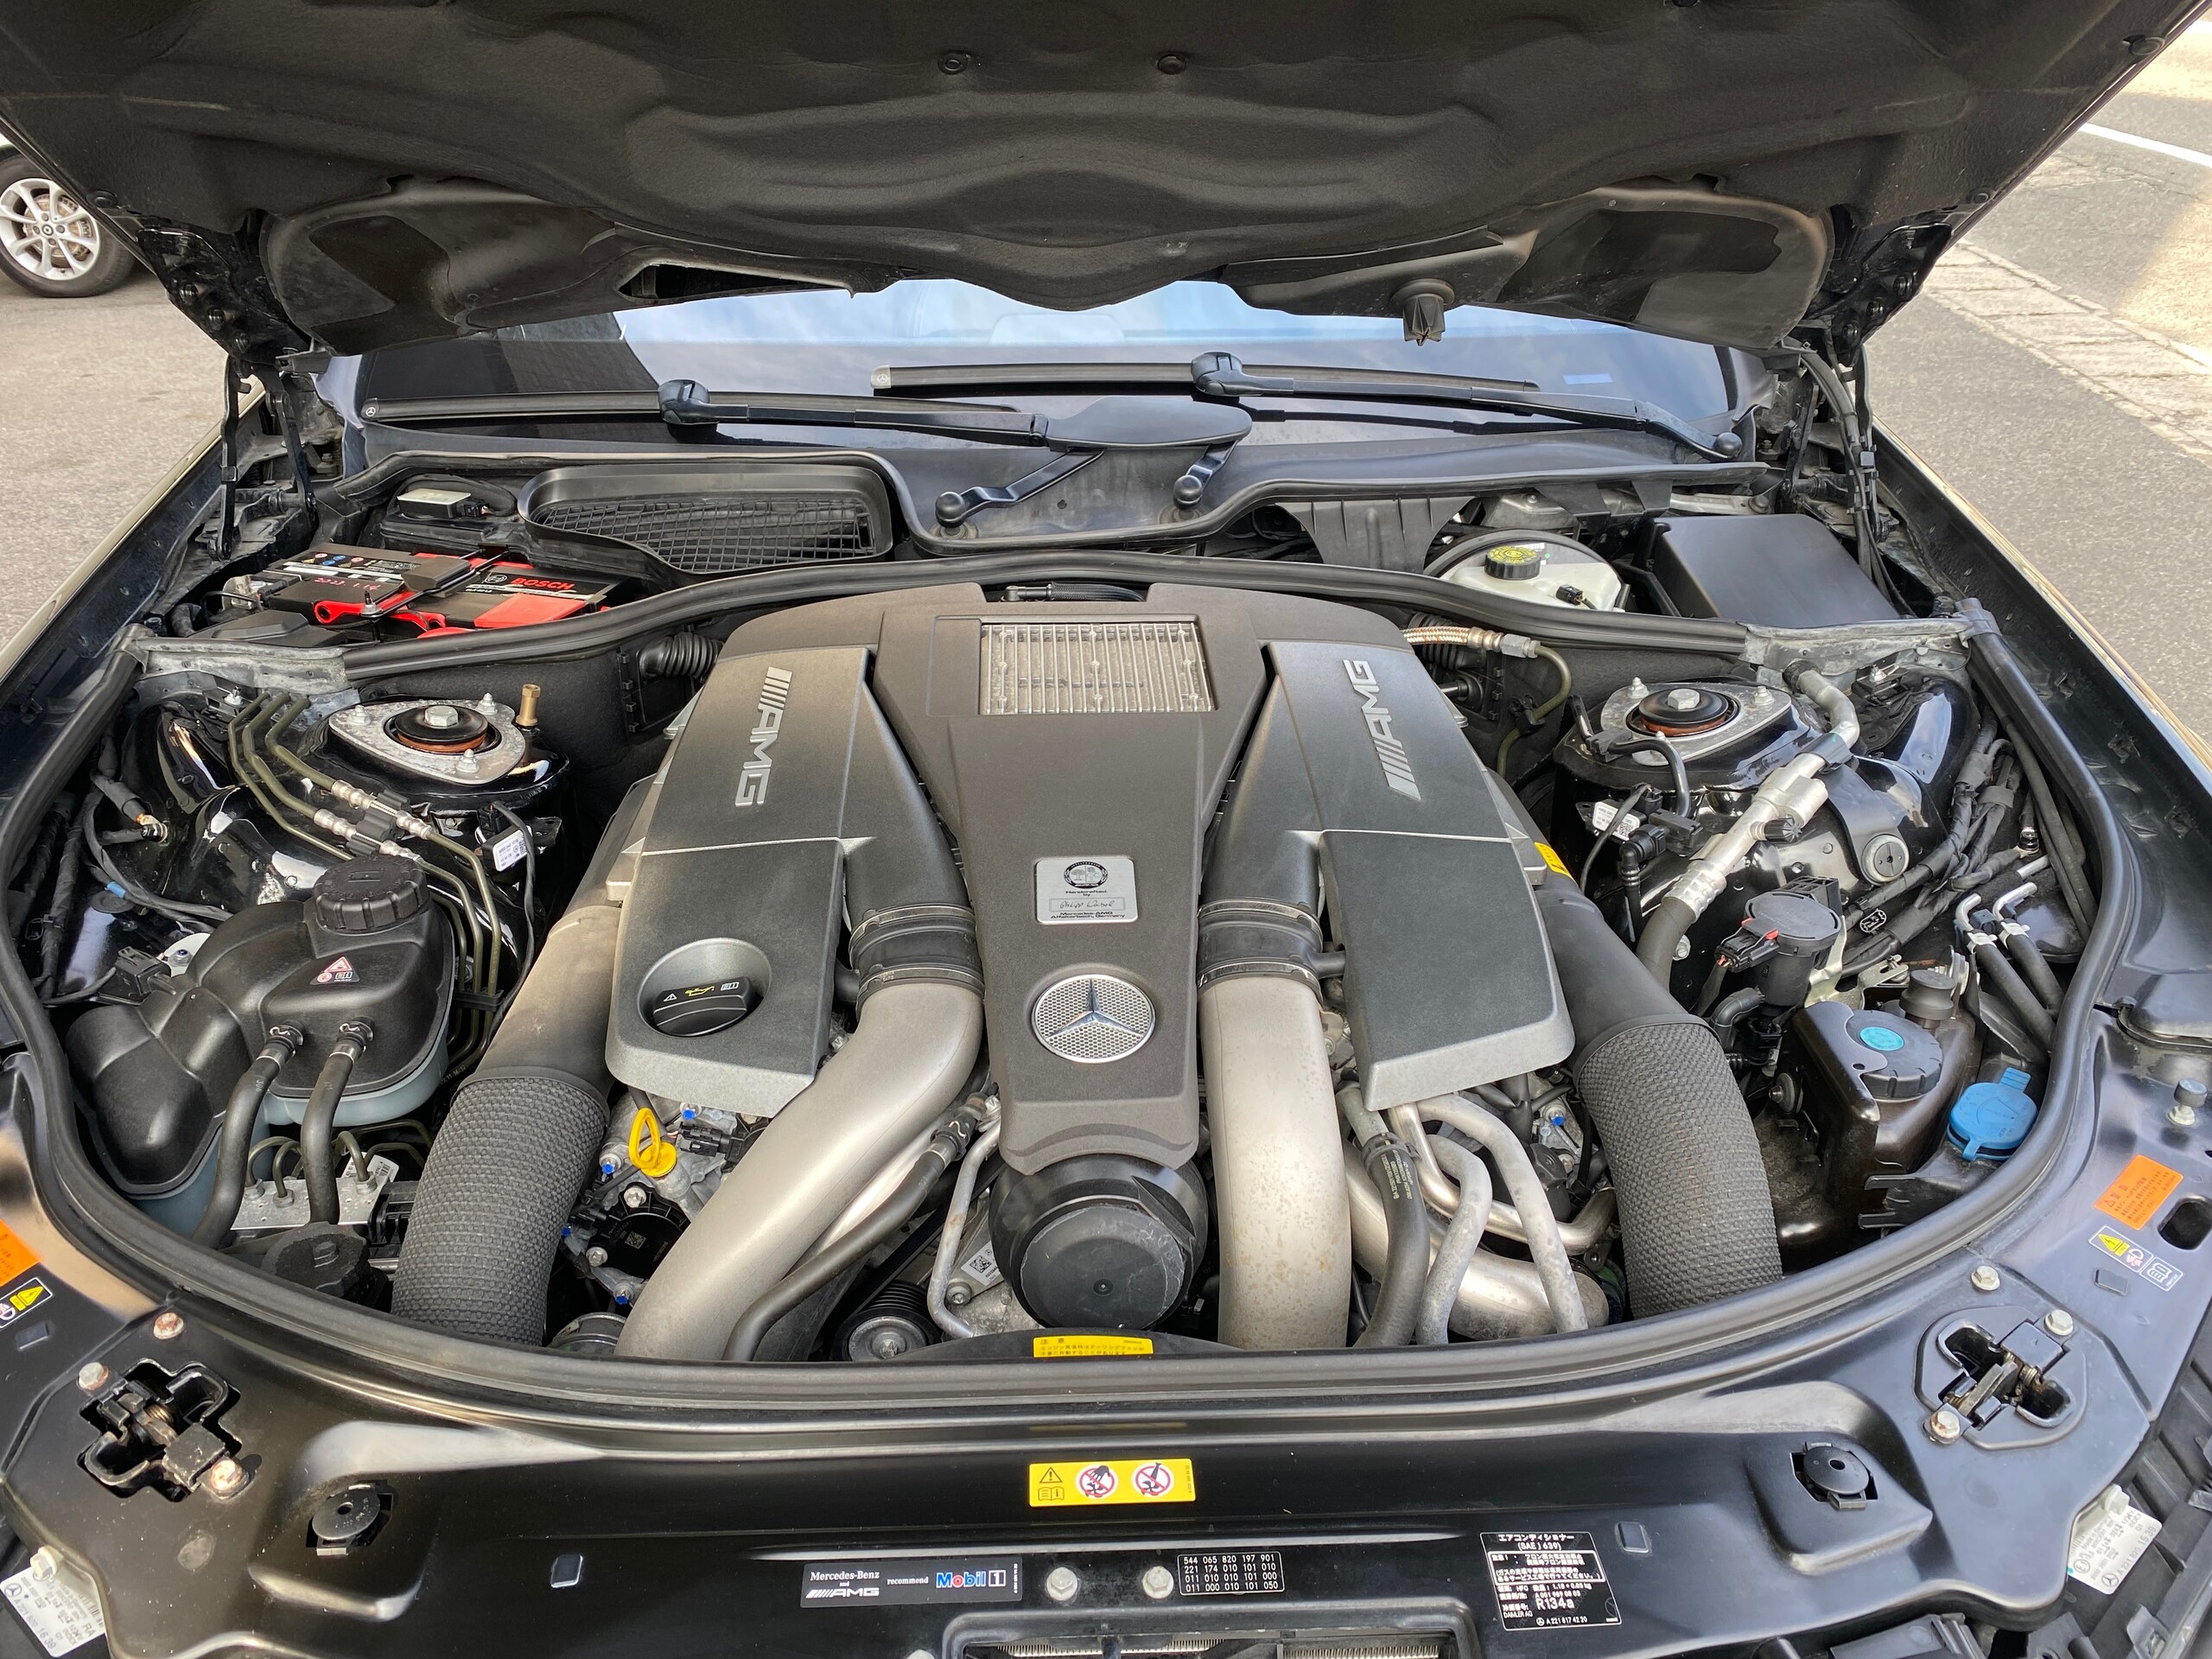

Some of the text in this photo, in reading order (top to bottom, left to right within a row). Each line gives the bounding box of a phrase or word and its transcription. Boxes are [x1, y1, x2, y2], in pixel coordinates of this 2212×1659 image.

[511, 577, 575, 590] BOSCH
[1184, 1556, 1198, 1565] 544
[1203, 1555, 1217, 1564] 065
[1242, 1554, 1255, 1563] 197
[1261, 1554, 1274, 1562] 901
[1223, 1564, 1238, 1573] 010
[1243, 1563, 1256, 1572] 101
[1262, 1562, 1276, 1571] 010
[810, 1570, 880, 1581] Mercedes-Benz
[887, 1576, 929, 1586] recommend
[936, 1571, 987, 1589] Mobil
[1244, 1573, 1257, 1581] 101
[1262, 1572, 1277, 1580] 000
[1185, 1584, 1200, 1592] 011
[1224, 1582, 1239, 1591] 010
[1245, 1581, 1258, 1590] 101
[1535, 1597, 1575, 1611] R134a
